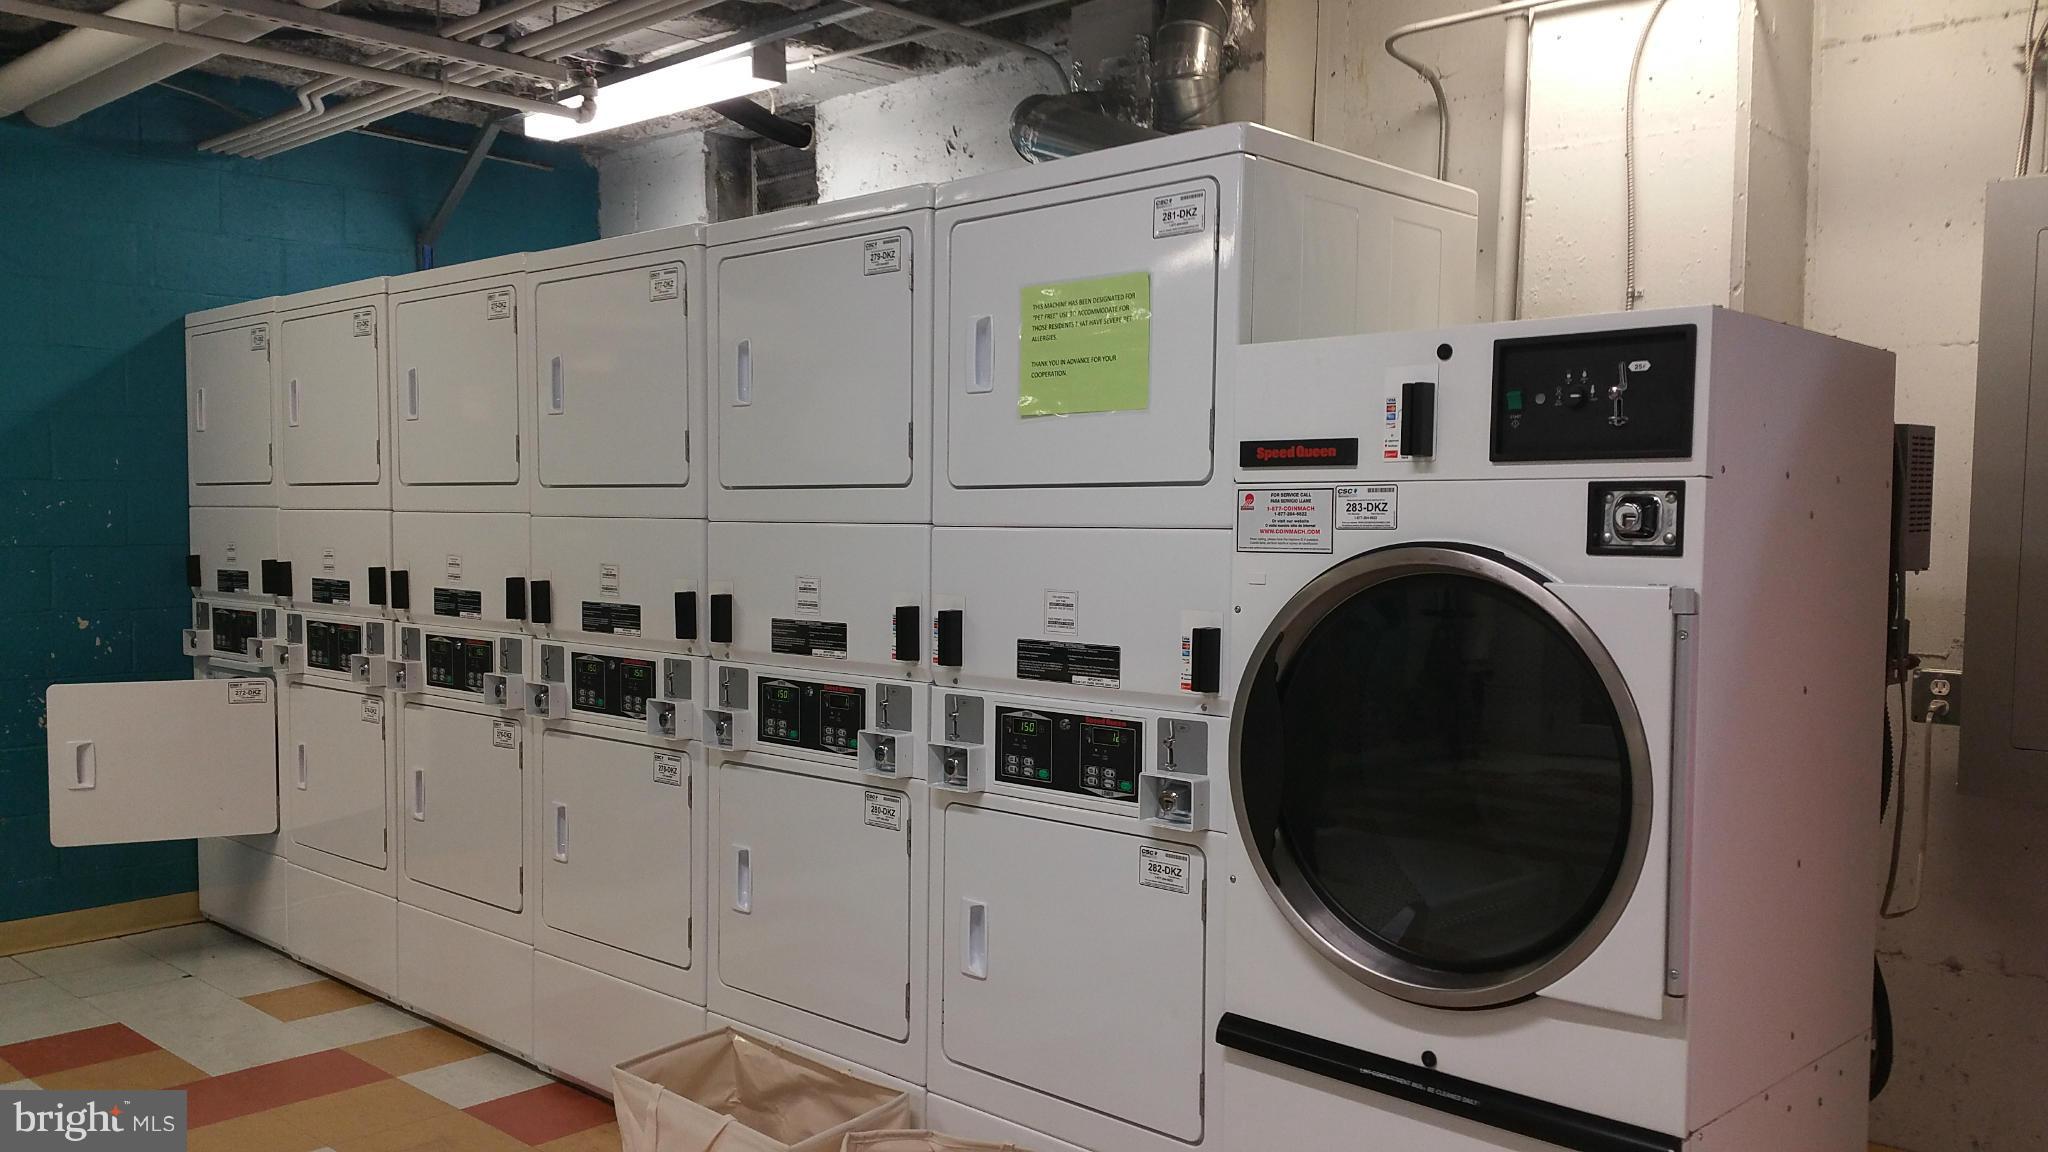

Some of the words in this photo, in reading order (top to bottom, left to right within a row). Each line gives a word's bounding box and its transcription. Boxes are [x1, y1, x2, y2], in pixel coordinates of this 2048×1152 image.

[1162, 207, 1198, 222] 281-DKZ
[1093, 294, 1125, 304] DESIGNATED
[1125, 292, 1136, 300] FOR
[1078, 306, 1118, 316] ACCOMMODATE
[1119, 304, 1130, 312] FOR
[1032, 324, 1047, 332] THOSE
[1049, 321, 1074, 330] RESIDENTS
[1089, 318, 1103, 326] HAVE
[1067, 356, 1090, 365] ADVANCE
[1102, 354, 1117, 362] YOUR
[1256, 446, 1295, 461] Speed
[1296, 445, 1337, 458] Queen
[1345, 502, 1389, 513] 283-DKZ
[777, 690, 788, 699] 150
[1021, 721, 1035, 732] 150
[870, 805, 896, 817] 280-DKZ
[1148, 862, 1182, 877] 282-DKZ
